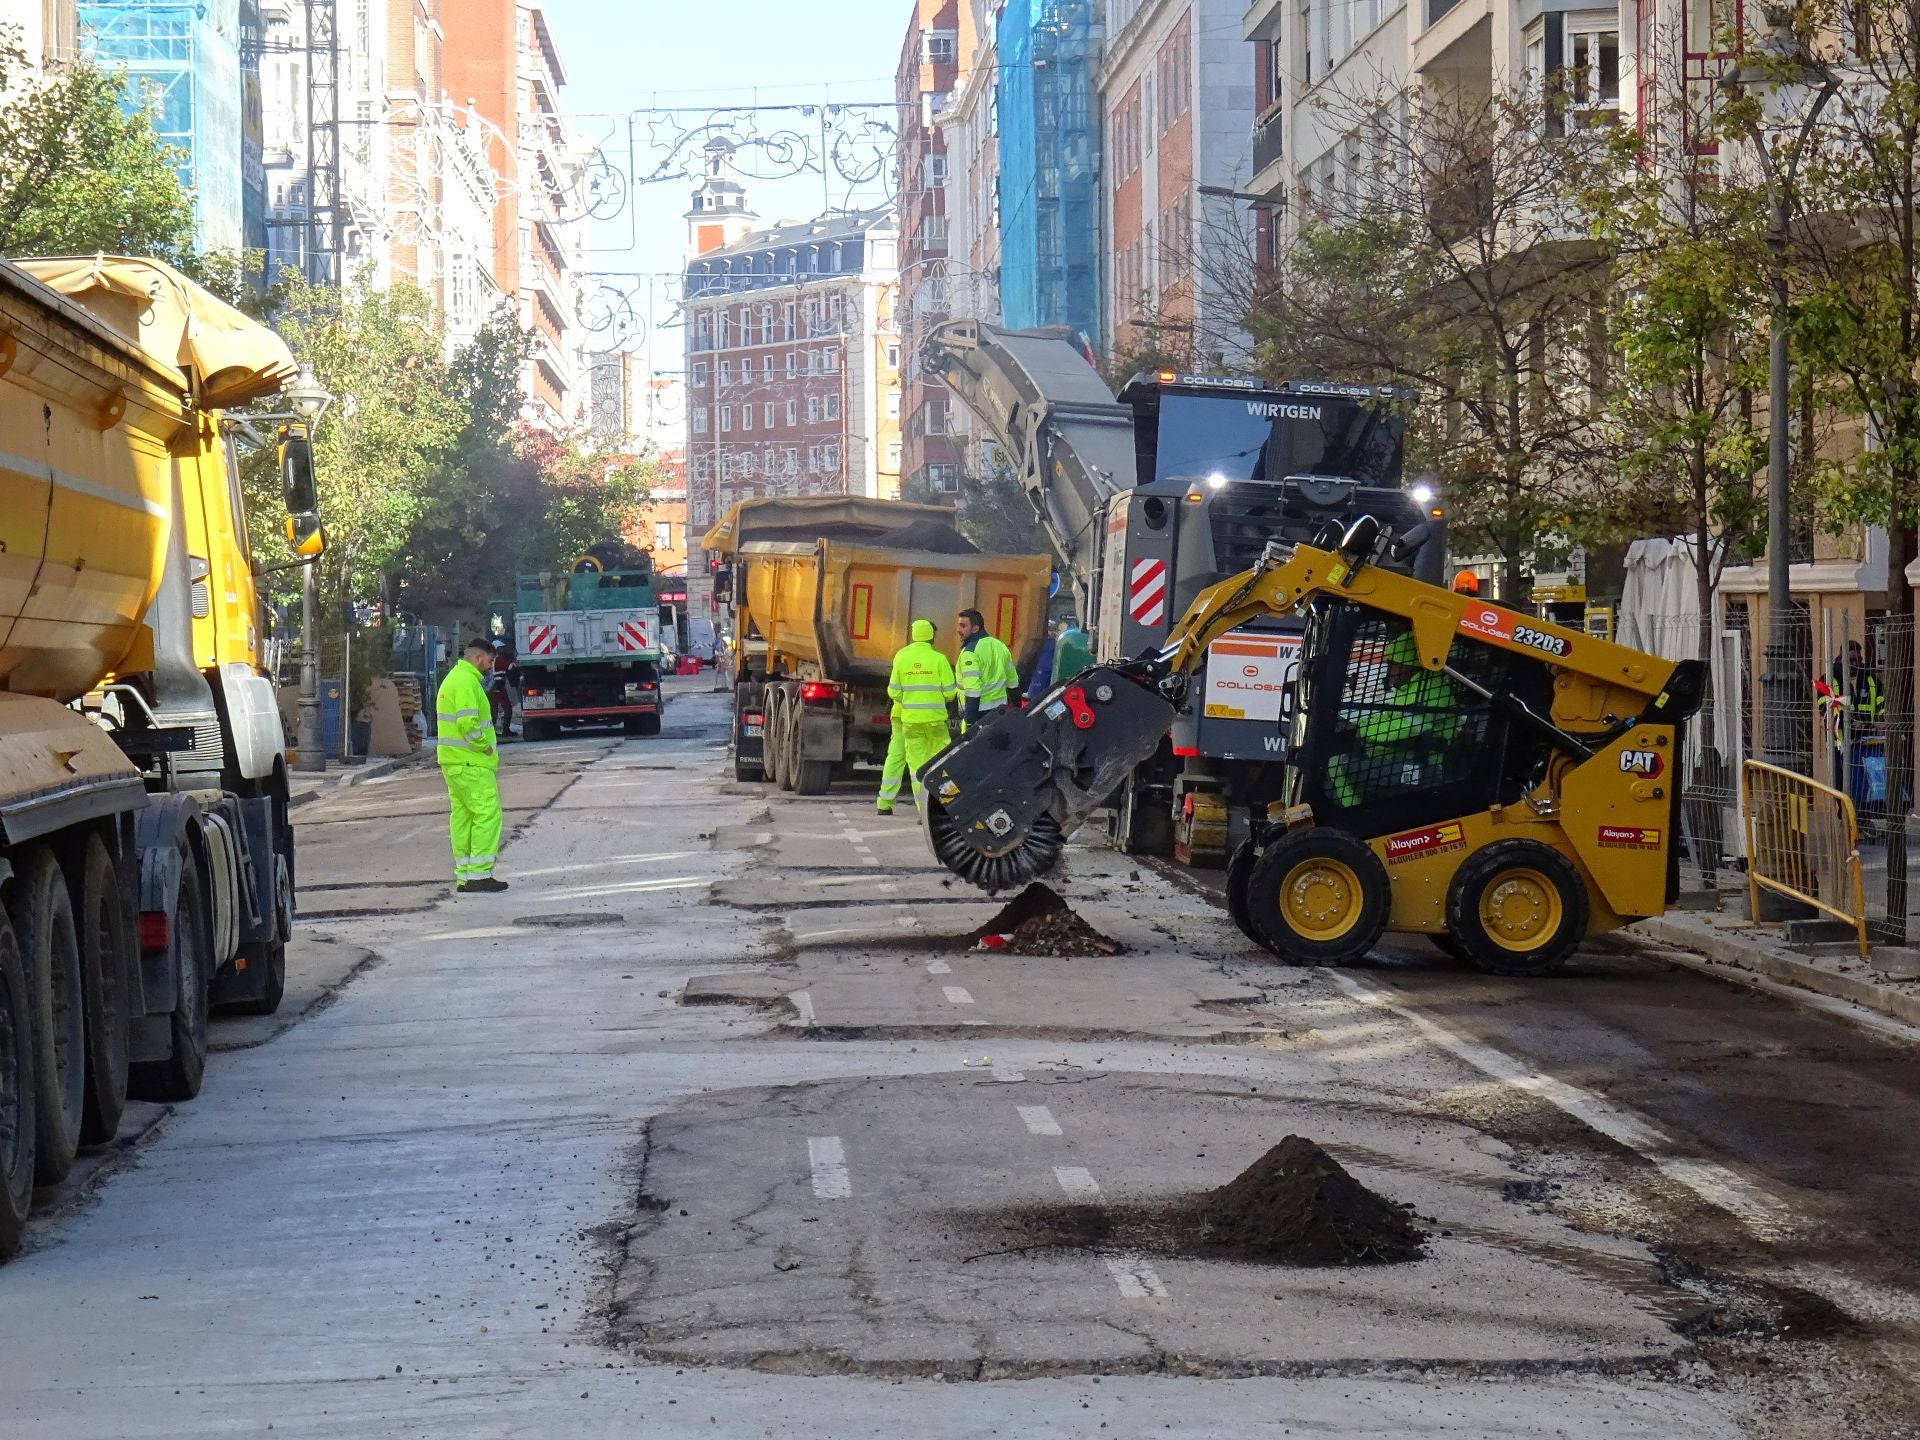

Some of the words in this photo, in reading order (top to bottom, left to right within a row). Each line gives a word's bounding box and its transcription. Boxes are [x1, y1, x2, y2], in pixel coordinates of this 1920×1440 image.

[1183, 376, 1254, 388] COLLOSA
[1300, 384, 1370, 396] COLLOSA
[1247, 402, 1321, 420] WIRTGEN
[1460, 619, 1511, 640] COLLOSA
[1513, 626, 1565, 655] 232D3
[1279, 646, 1294, 659] W
[1216, 681, 1283, 691] COLLOSA
[1263, 736, 1286, 752] WI
[1620, 750, 1655, 773] CAT
[1603, 829, 1630, 839] Alayan
[1391, 836, 1424, 851] Alayan
[1388, 851, 1424, 866] ALQUILER
